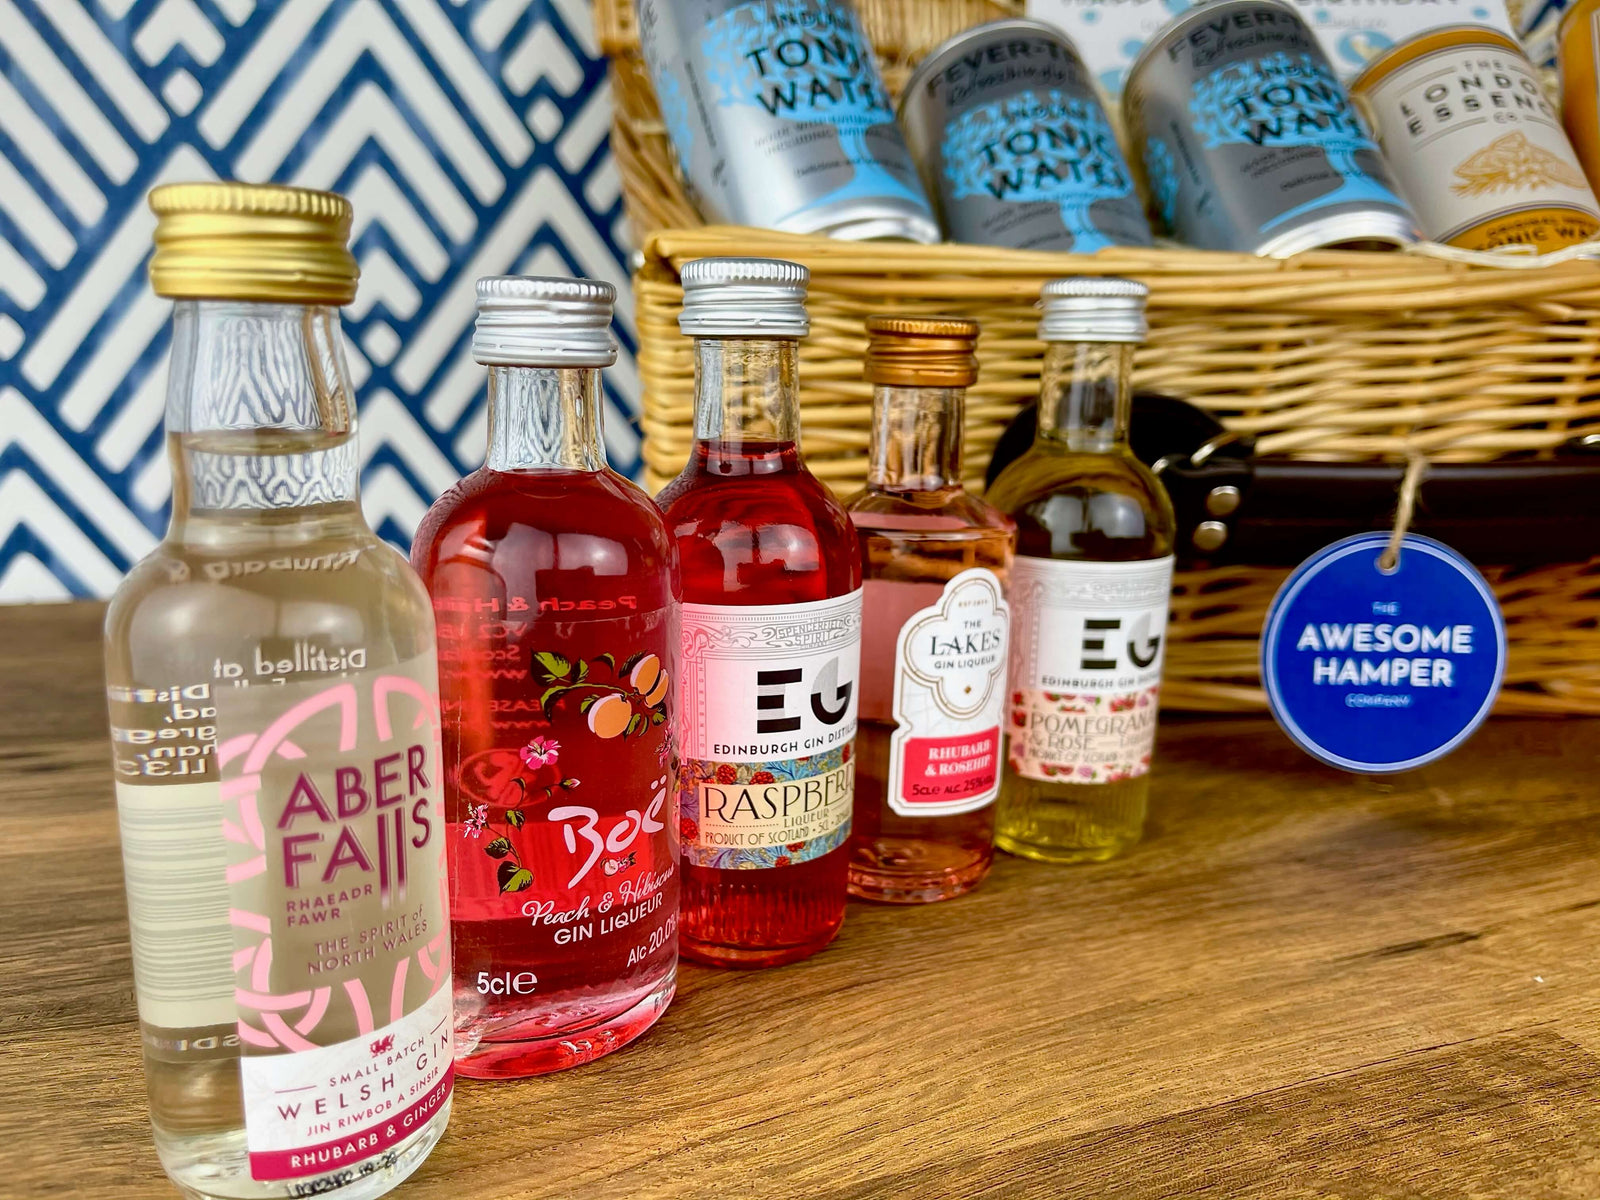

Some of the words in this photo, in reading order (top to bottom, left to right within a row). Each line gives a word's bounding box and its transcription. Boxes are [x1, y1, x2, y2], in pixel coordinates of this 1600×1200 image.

[964, 620, 982, 629] THE
[1081, 610, 1160, 669] EG
[1297, 622, 1474, 654] AWESOME
[928, 628, 1001, 656] LAKES
[934, 660, 954, 669] GIN
[958, 655, 995, 669] LIQUEUR
[1313, 656, 1455, 688] HAMPER
[757, 656, 853, 734] EG
[1041, 676, 1113, 688] EDINBURGH
[713, 741, 798, 755] EDINBURGH
[803, 736, 824, 749] GIN
[928, 739, 991, 760] RHUBARB
[924, 763, 937, 777] &
[939, 754, 991, 775] ROSEHIP
[277, 744, 431, 830] ABER
[783, 807, 829, 828] LIQUEUR
[705, 831, 744, 846] PRODUCT
[747, 831, 765, 846] OF
[768, 825, 810, 844] SCOTLAND
[286, 884, 373, 914] RHAEADR
[521, 895, 591, 926] Peach
[598, 892, 614, 914] &
[287, 907, 341, 928] FAWR
[314, 935, 349, 956] THE
[360, 913, 407, 944] SPIRIT
[412, 904, 423, 921] of
[553, 923, 593, 945] GIN
[601, 891, 663, 935] LIQUEUR
[308, 946, 376, 975] NORTH
[383, 919, 427, 952] WALES
[627, 945, 647, 968] Alc
[278, 1073, 395, 1121] WELSH
[415, 1029, 449, 1071] GIN
[329, 1062, 380, 1087] SMALL
[386, 1037, 425, 1066] BATCH
[307, 1122, 331, 1137] JIN
[337, 1099, 392, 1129] RIWBOB
[397, 1093, 405, 1105] A
[408, 1066, 439, 1097] SINSIR
[291, 1133, 379, 1169] RHUBARB
[386, 1124, 397, 1138] &
[403, 1082, 447, 1128] GINGER
